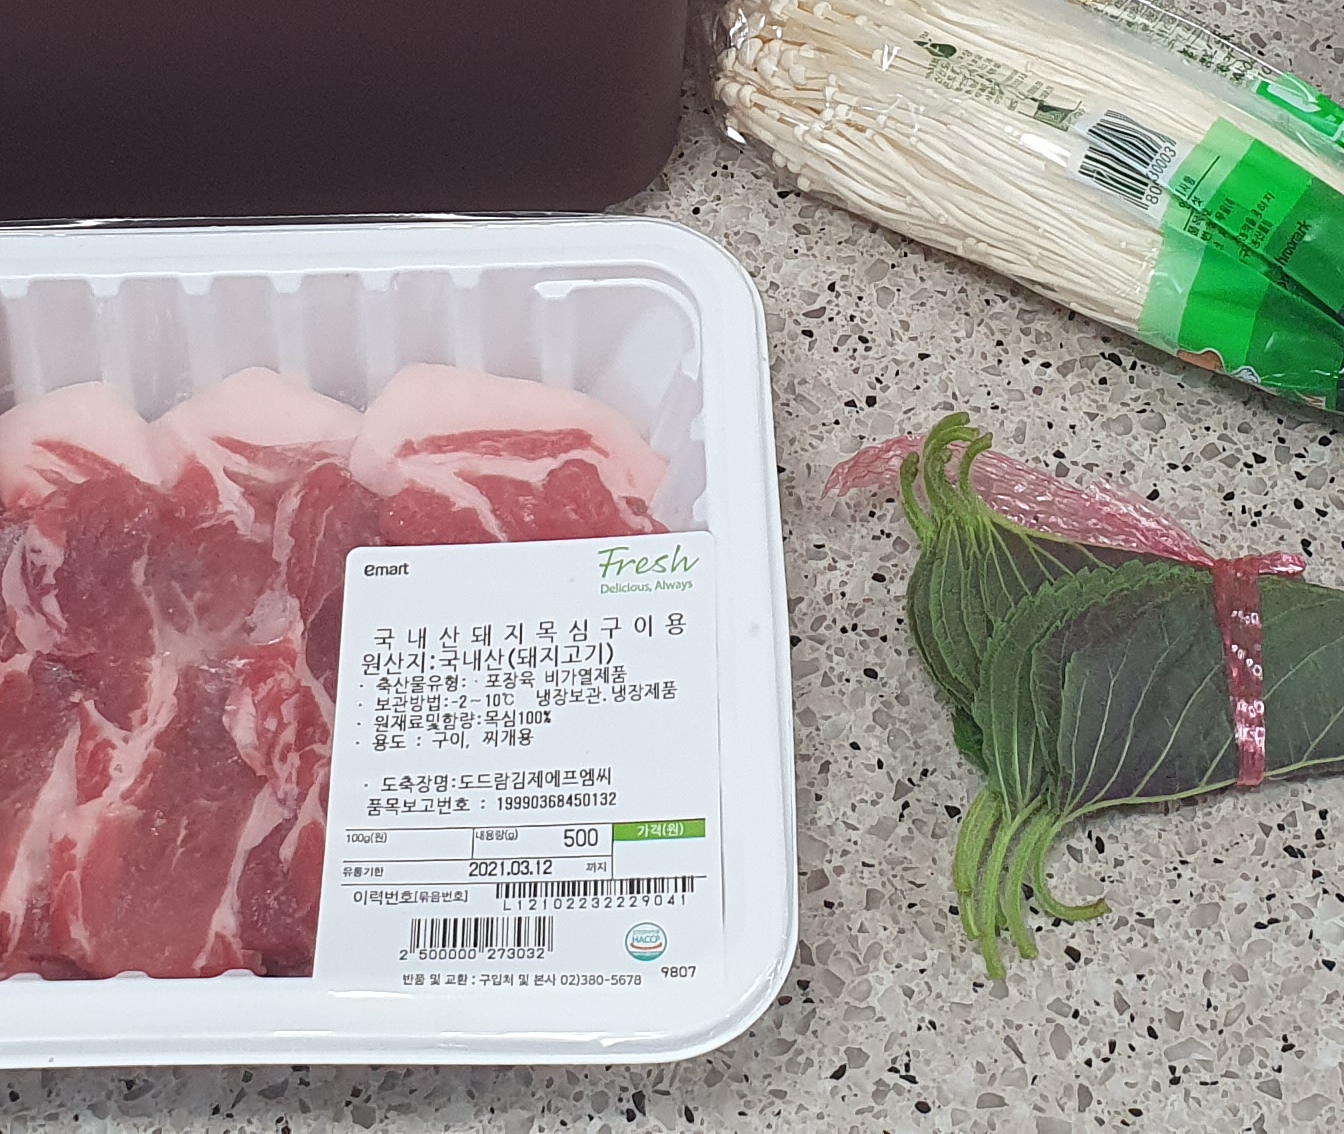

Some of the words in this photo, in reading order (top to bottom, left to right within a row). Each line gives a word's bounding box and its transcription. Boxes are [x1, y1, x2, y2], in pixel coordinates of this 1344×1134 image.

[597, 544, 701, 578] Fresh
[364, 562, 410, 577] emart
[600, 581, 653, 594] Delicious,
[655, 578, 693, 592] Always
[484, 670, 535, 690] 포장육
[545, 665, 628, 687] 비가열제품
[372, 733, 407, 752] 용도
[432, 730, 470, 750] 구이,
[482, 728, 534, 748] 찌개용
[367, 796, 471, 817] 품목보고번호
[496, 791, 617, 812] 19990368450132
[475, 829, 519, 842] 내용량(g)
[637, 822, 685, 837] 가격(원)
[346, 832, 388, 844] 100g(원)
[564, 828, 599, 848] 500
[343, 866, 384, 878] 유통기한
[468, 859, 553, 877] 2021.03.12
[586, 861, 607, 873] 까지
[632, 935, 660, 944] HACCP
[419, 948, 477, 960] 500000
[487, 947, 545, 959] 273032
[661, 965, 697, 978] 9807
[402, 973, 426, 986] 반품
[430, 973, 441, 986] 및
[445, 973, 468, 986] 교환
[479, 973, 514, 986] 구입처
[519, 973, 530, 986] 및
[534, 973, 556, 986] 본사
[560, 973, 642, 987] 02)380-5678
